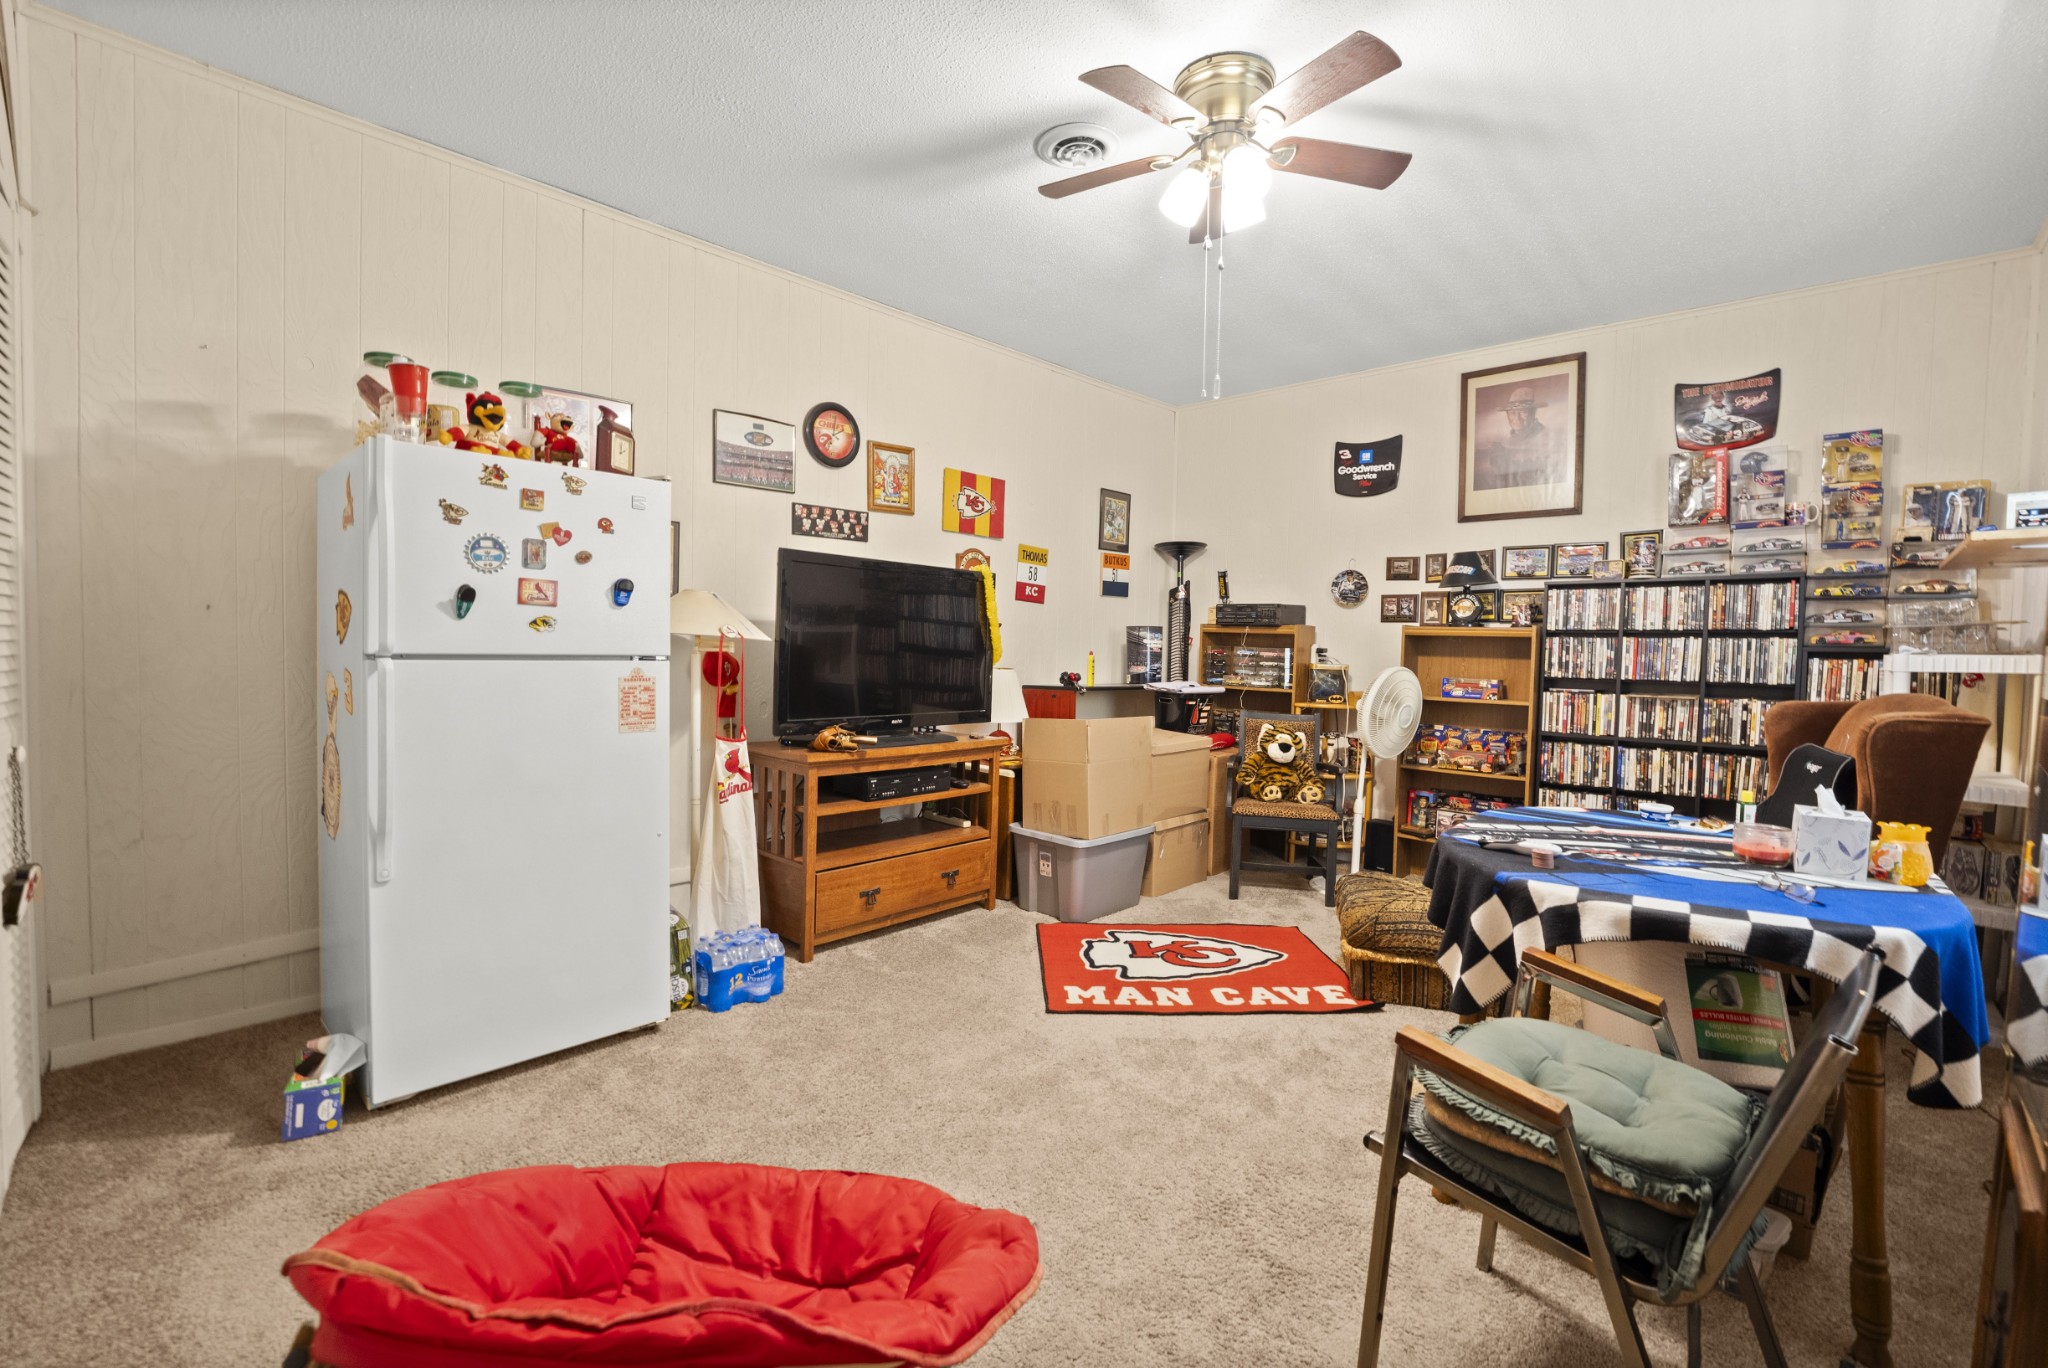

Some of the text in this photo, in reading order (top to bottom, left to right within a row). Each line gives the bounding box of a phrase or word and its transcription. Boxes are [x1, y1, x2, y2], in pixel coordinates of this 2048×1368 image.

[1339, 450, 1352, 459] 3
[1338, 462, 1395, 475] Goodwrench
[1352, 472, 1377, 481] Service
[965, 494, 985, 513] KC
[1022, 549, 1048, 563] THOMAS
[1104, 554, 1128, 567] BUTKUS
[1027, 566, 1038, 581] 58
[1111, 568, 1118, 582] 51
[1025, 585, 1039, 597] KC
[1124, 940, 1241, 968] KC
[727, 973, 744, 996] 12
[1063, 984, 1358, 1007] MAN CAVE
[1704, 1029, 1754, 1044] Cushioning
